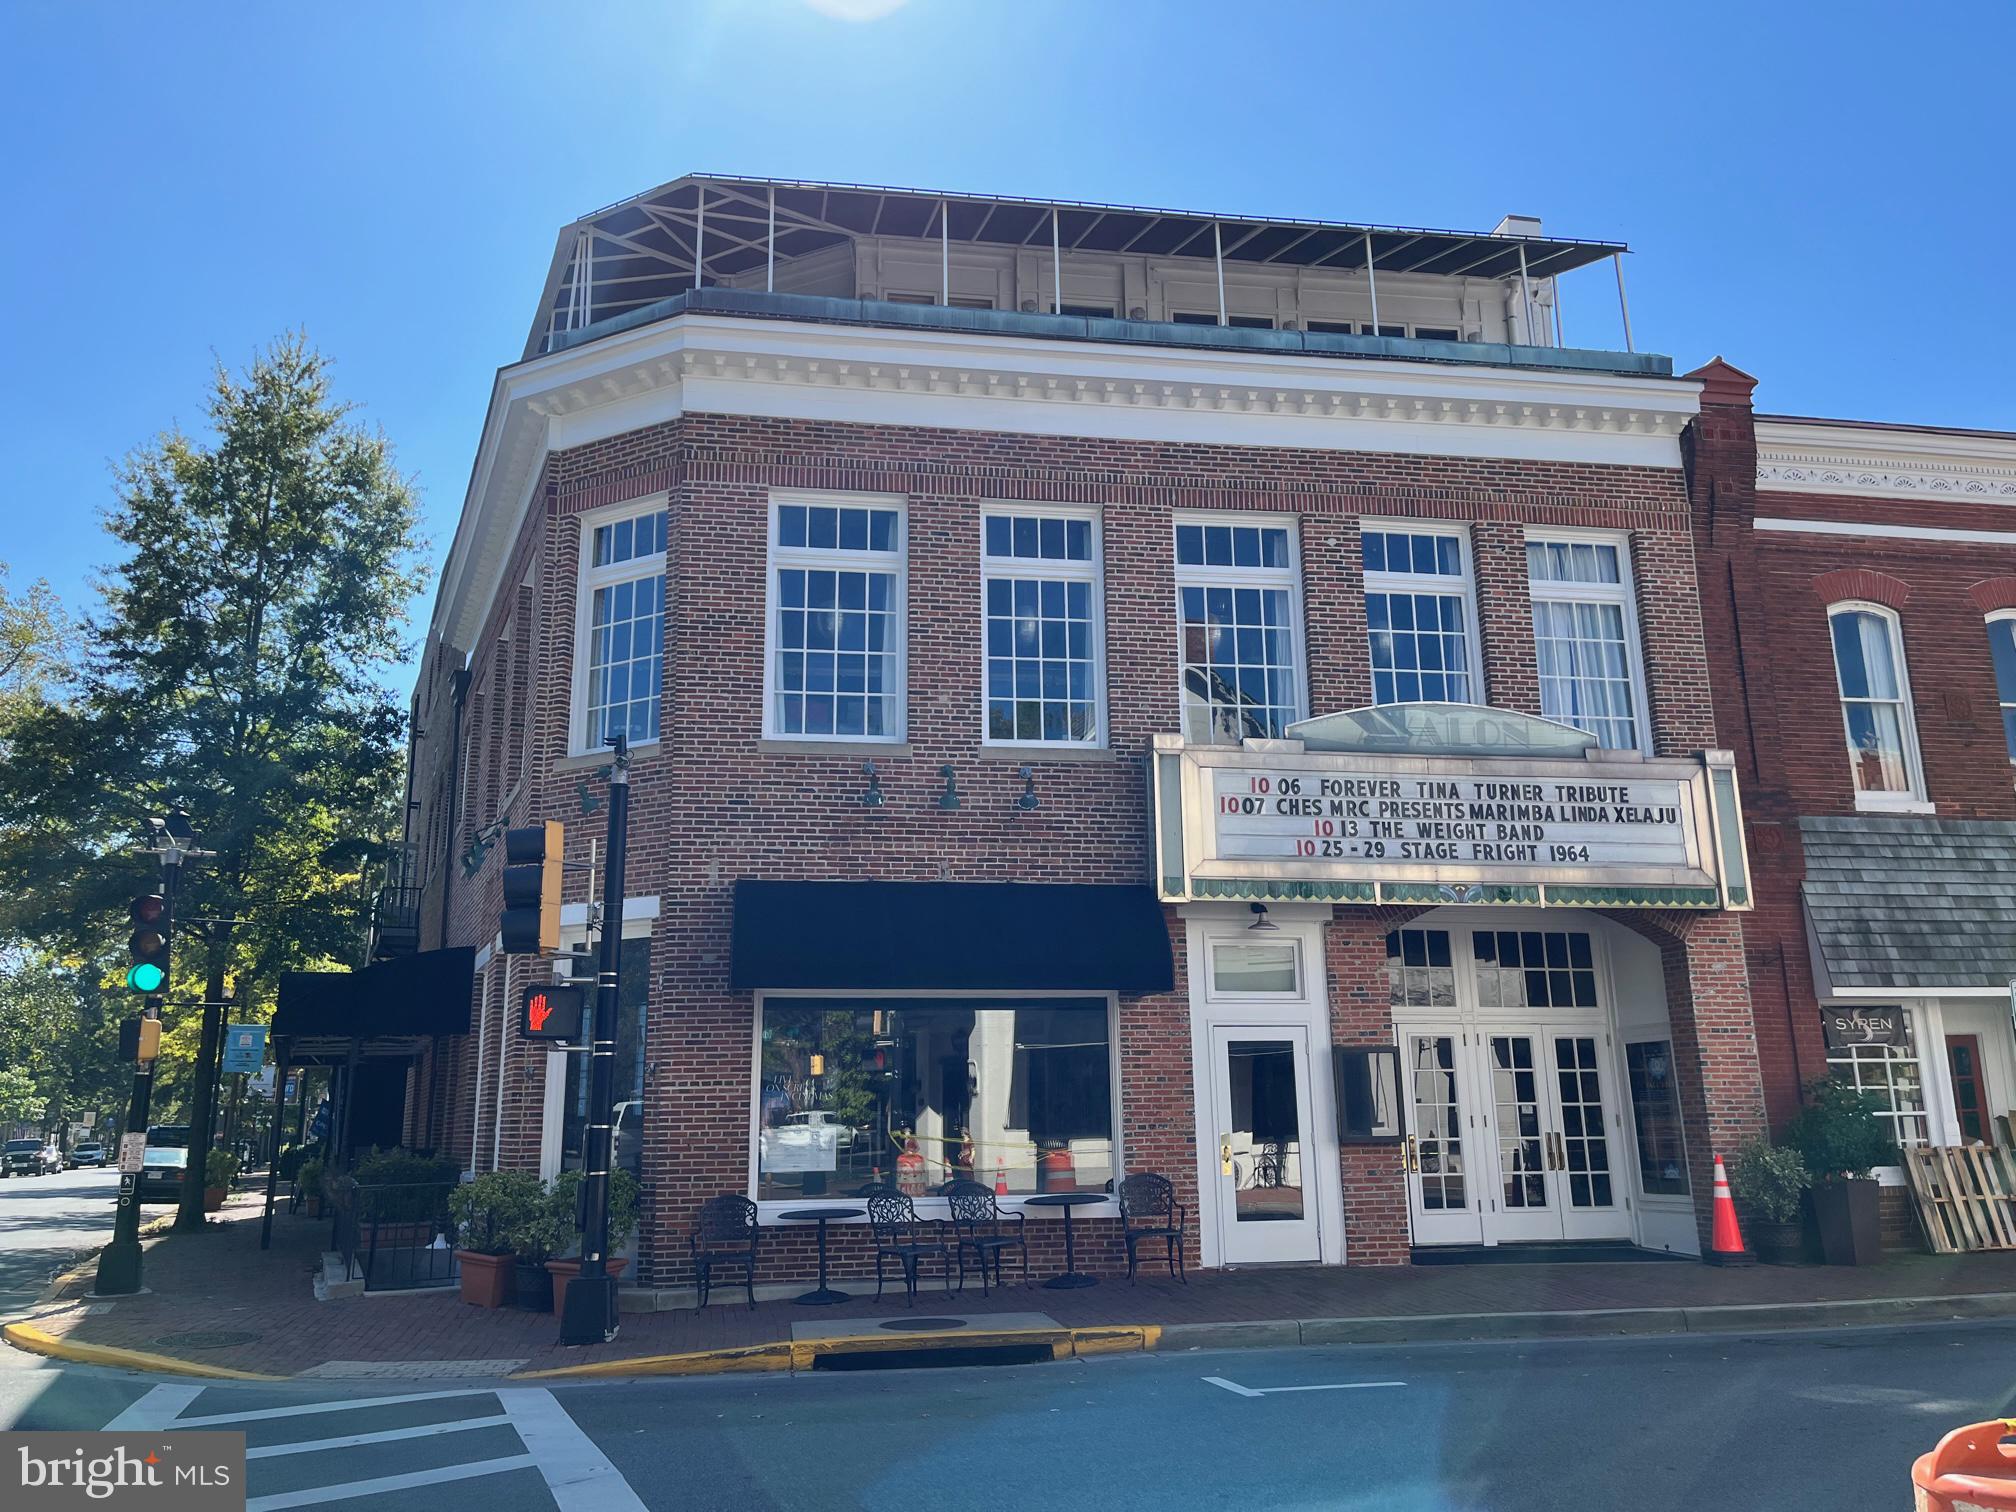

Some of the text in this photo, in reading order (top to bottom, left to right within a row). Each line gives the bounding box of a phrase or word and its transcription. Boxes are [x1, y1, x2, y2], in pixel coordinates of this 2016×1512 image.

[1251, 777, 1629, 803] 10 06 FOREVER TINA TURNER TRIBUTE
[1277, 799, 1323, 816] CHES
[1330, 800, 1370, 817] MRC
[1379, 801, 1465, 819] PRESENTS
[1469, 804, 1555, 822] MARIMBA
[1560, 806, 1609, 823] LINDA
[1615, 807, 1676, 823] XELAJU
[1314, 819, 1544, 841] 10 13 THE WEIGHT BAND
[1296, 840, 1316, 857] 10
[1322, 840, 1344, 857] 25
[1364, 841, 1385, 858] 29
[1401, 842, 1458, 860] STAGE
[1472, 843, 1537, 862] FRIGHT
[1550, 845, 1590, 862] 1964
[1835, 1017, 1893, 1030] SYREN
